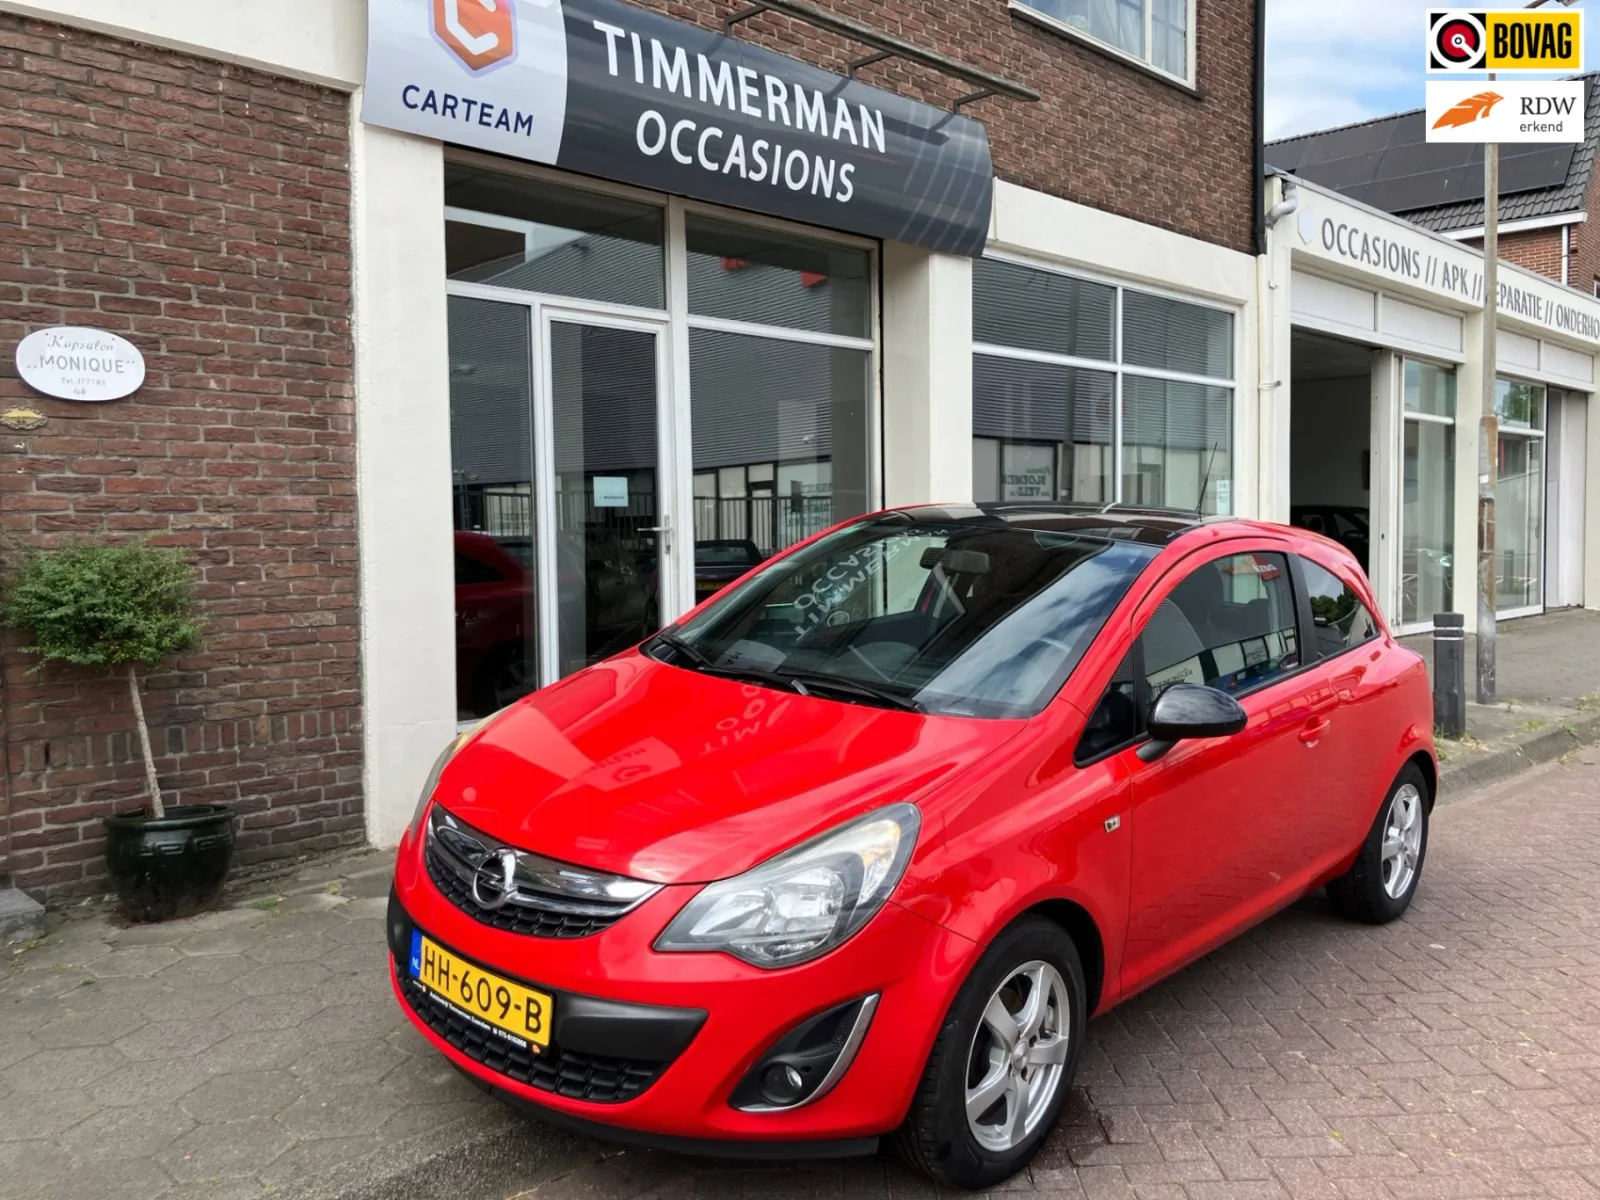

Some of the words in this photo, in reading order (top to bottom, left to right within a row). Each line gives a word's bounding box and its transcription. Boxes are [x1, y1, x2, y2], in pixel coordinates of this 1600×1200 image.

[402, 84, 533, 137] CARTEAM
[592, 20, 888, 154] TIMMERMAN
[635, 109, 856, 203] OCCASIONS
[1321, 217, 1421, 280] OCCASIONS
[1442, 261, 1469, 296] APK
[411, 956, 420, 971] NL
[423, 944, 543, 1034] HH-609-B
